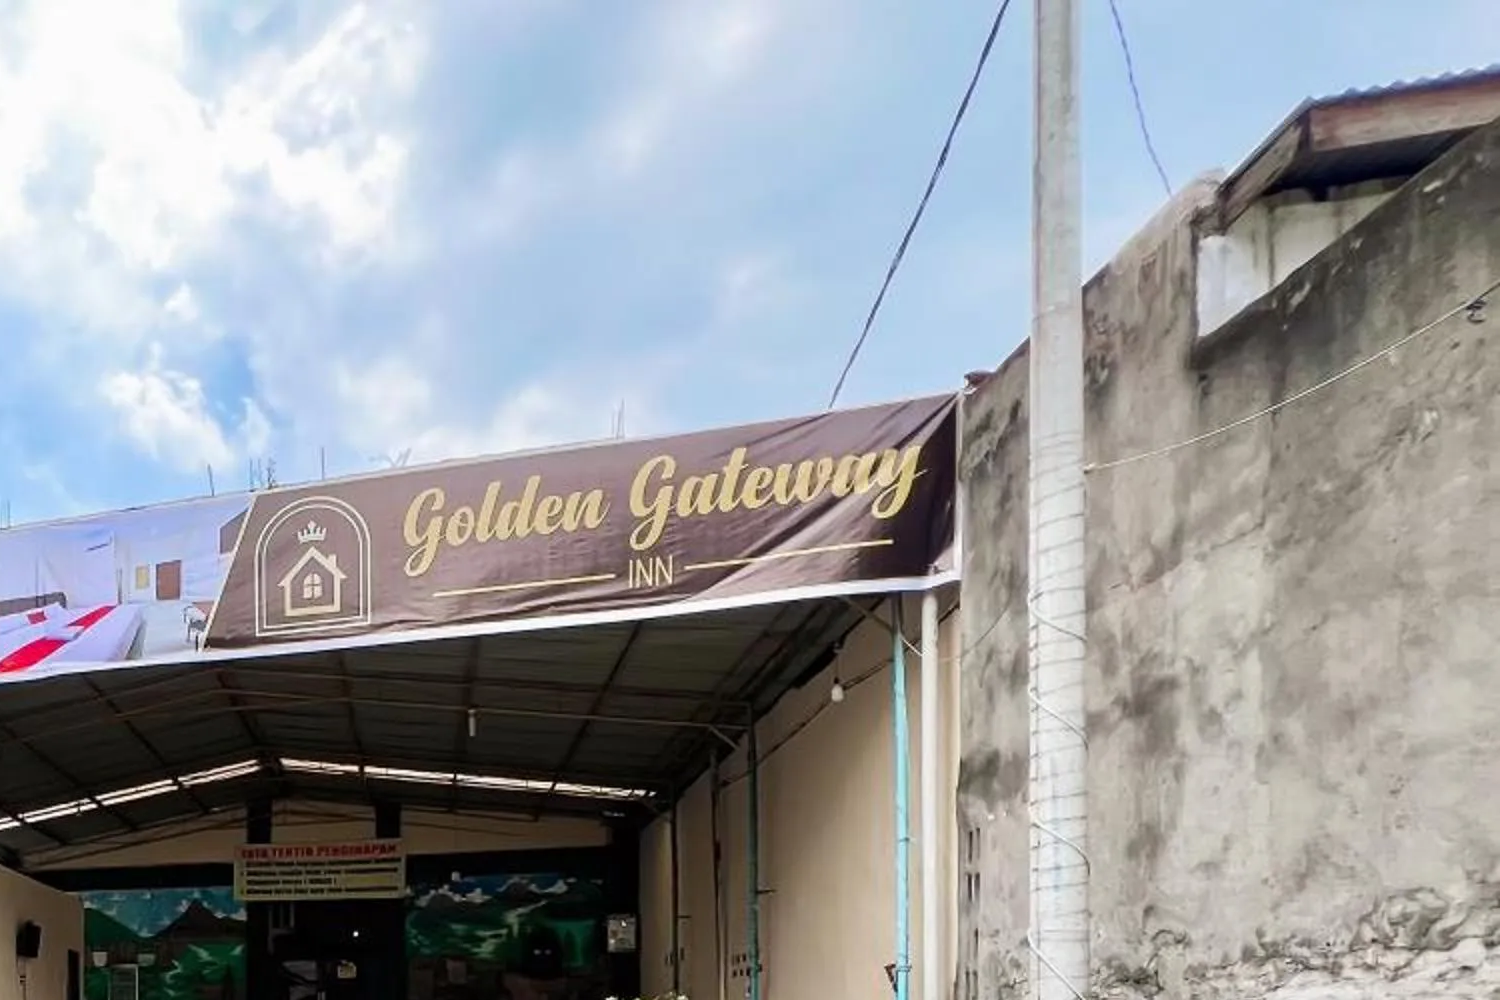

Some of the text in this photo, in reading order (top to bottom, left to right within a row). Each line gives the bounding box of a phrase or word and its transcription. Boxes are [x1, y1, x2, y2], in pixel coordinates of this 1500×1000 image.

[403, 445, 928, 577] Golden Gateway
[628, 555, 674, 589] INN
